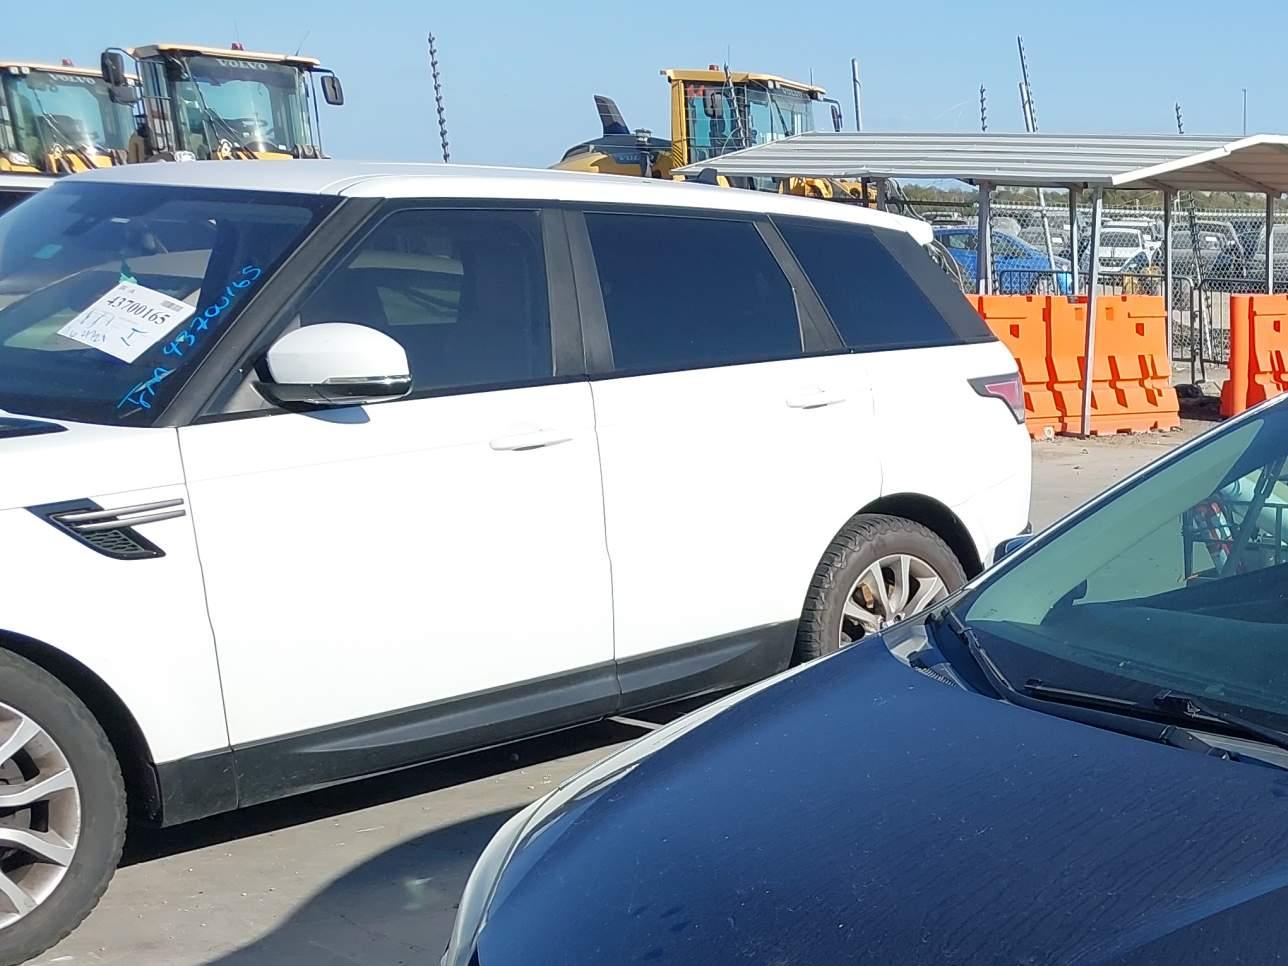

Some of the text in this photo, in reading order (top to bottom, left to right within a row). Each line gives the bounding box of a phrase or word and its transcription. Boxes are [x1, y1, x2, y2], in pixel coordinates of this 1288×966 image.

[216, 58, 268, 71] VOLVO
[48, 72, 96, 84] VOLVO
[107, 295, 171, 325] 43700165
